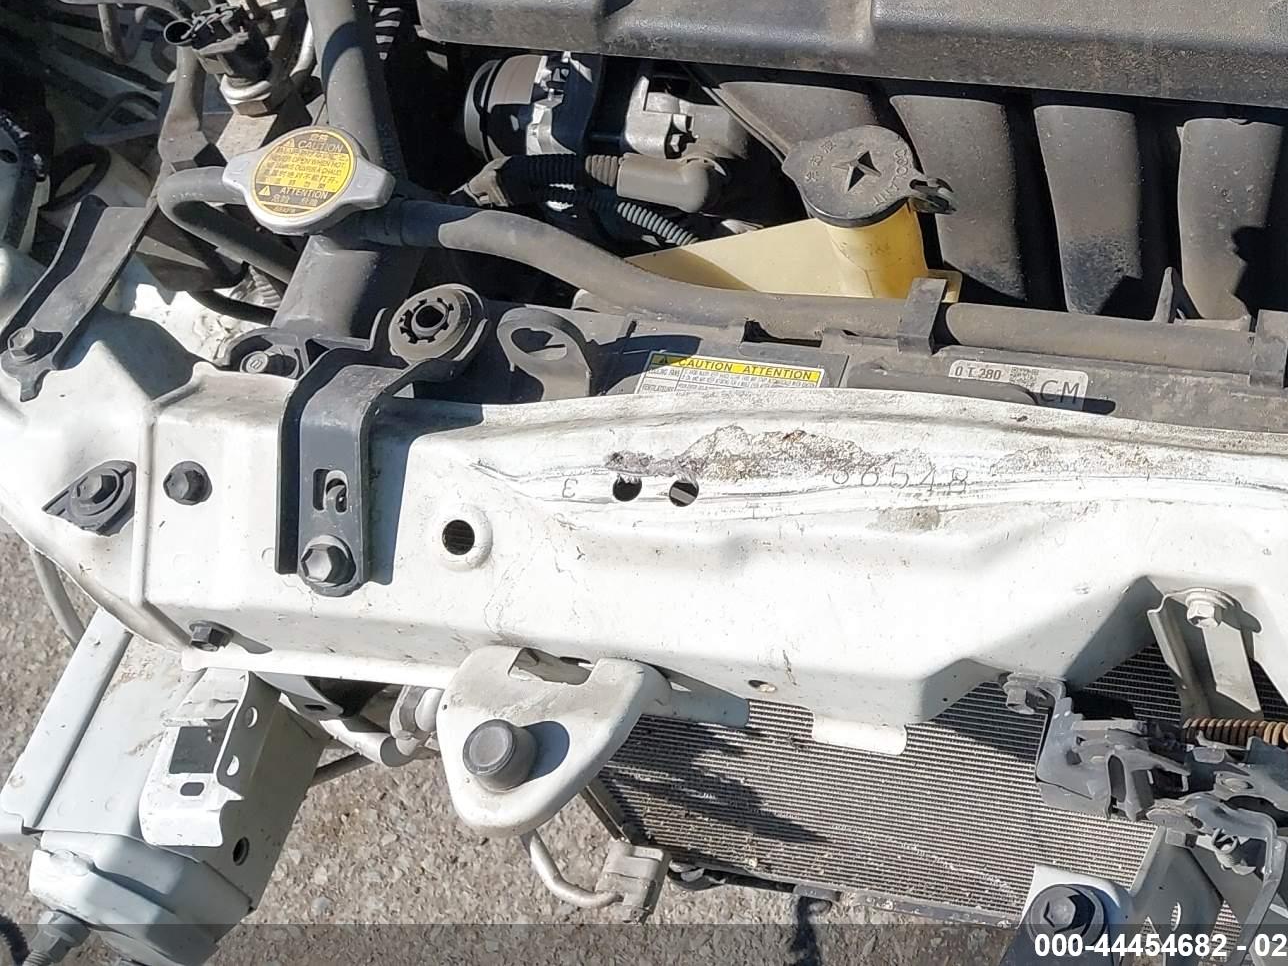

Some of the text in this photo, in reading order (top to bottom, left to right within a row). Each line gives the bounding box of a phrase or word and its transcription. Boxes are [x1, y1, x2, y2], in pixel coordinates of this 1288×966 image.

[298, 140, 343, 152] CAUTION
[280, 187, 328, 200] ATTENTION
[678, 358, 733, 372] CAUTION
[743, 365, 812, 380] ATTENTION
[1040, 380, 1080, 404] CM
